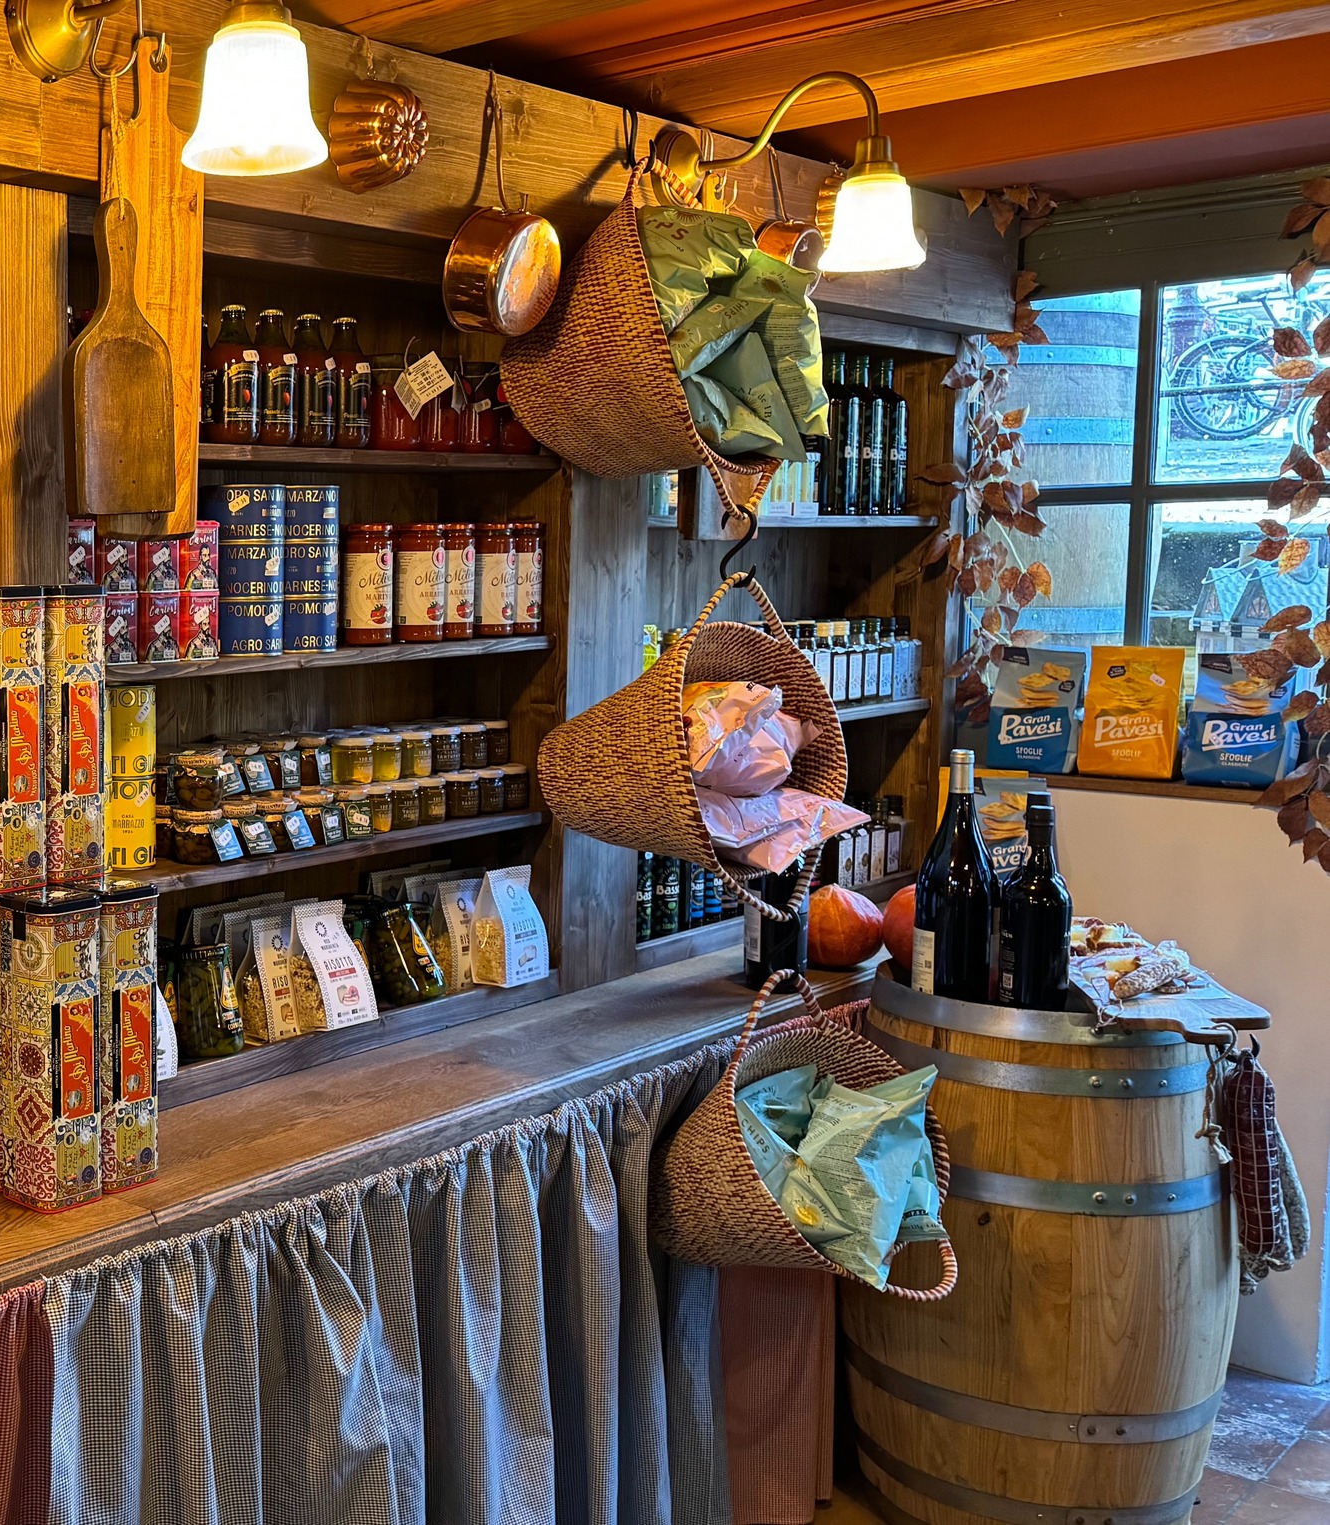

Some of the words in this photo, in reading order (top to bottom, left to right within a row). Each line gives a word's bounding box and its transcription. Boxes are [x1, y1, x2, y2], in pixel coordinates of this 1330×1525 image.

[254, 489, 275, 500] SAN
[287, 490, 335, 502] MARZANO
[225, 582, 278, 594] NOCERINO
[232, 640, 263, 650] AGRO
[294, 636, 323, 647] AGRO
[1023, 715, 1051, 723] Gran
[1119, 715, 1150, 724] Gran
[1000, 715, 1062, 742] Pavesi
[1094, 716, 1164, 742] Pavesi
[1230, 722, 1263, 731] Gran
[1202, 720, 1276, 745] Pavesi
[1016, 747, 1043, 756] SFOGLIE
[1220, 753, 1252, 762] SFOGLIE
[513, 917, 536, 932] RISOTTO
[324, 956, 354, 971] RISOTTO
[740, 1118, 770, 1155] CHIPS
